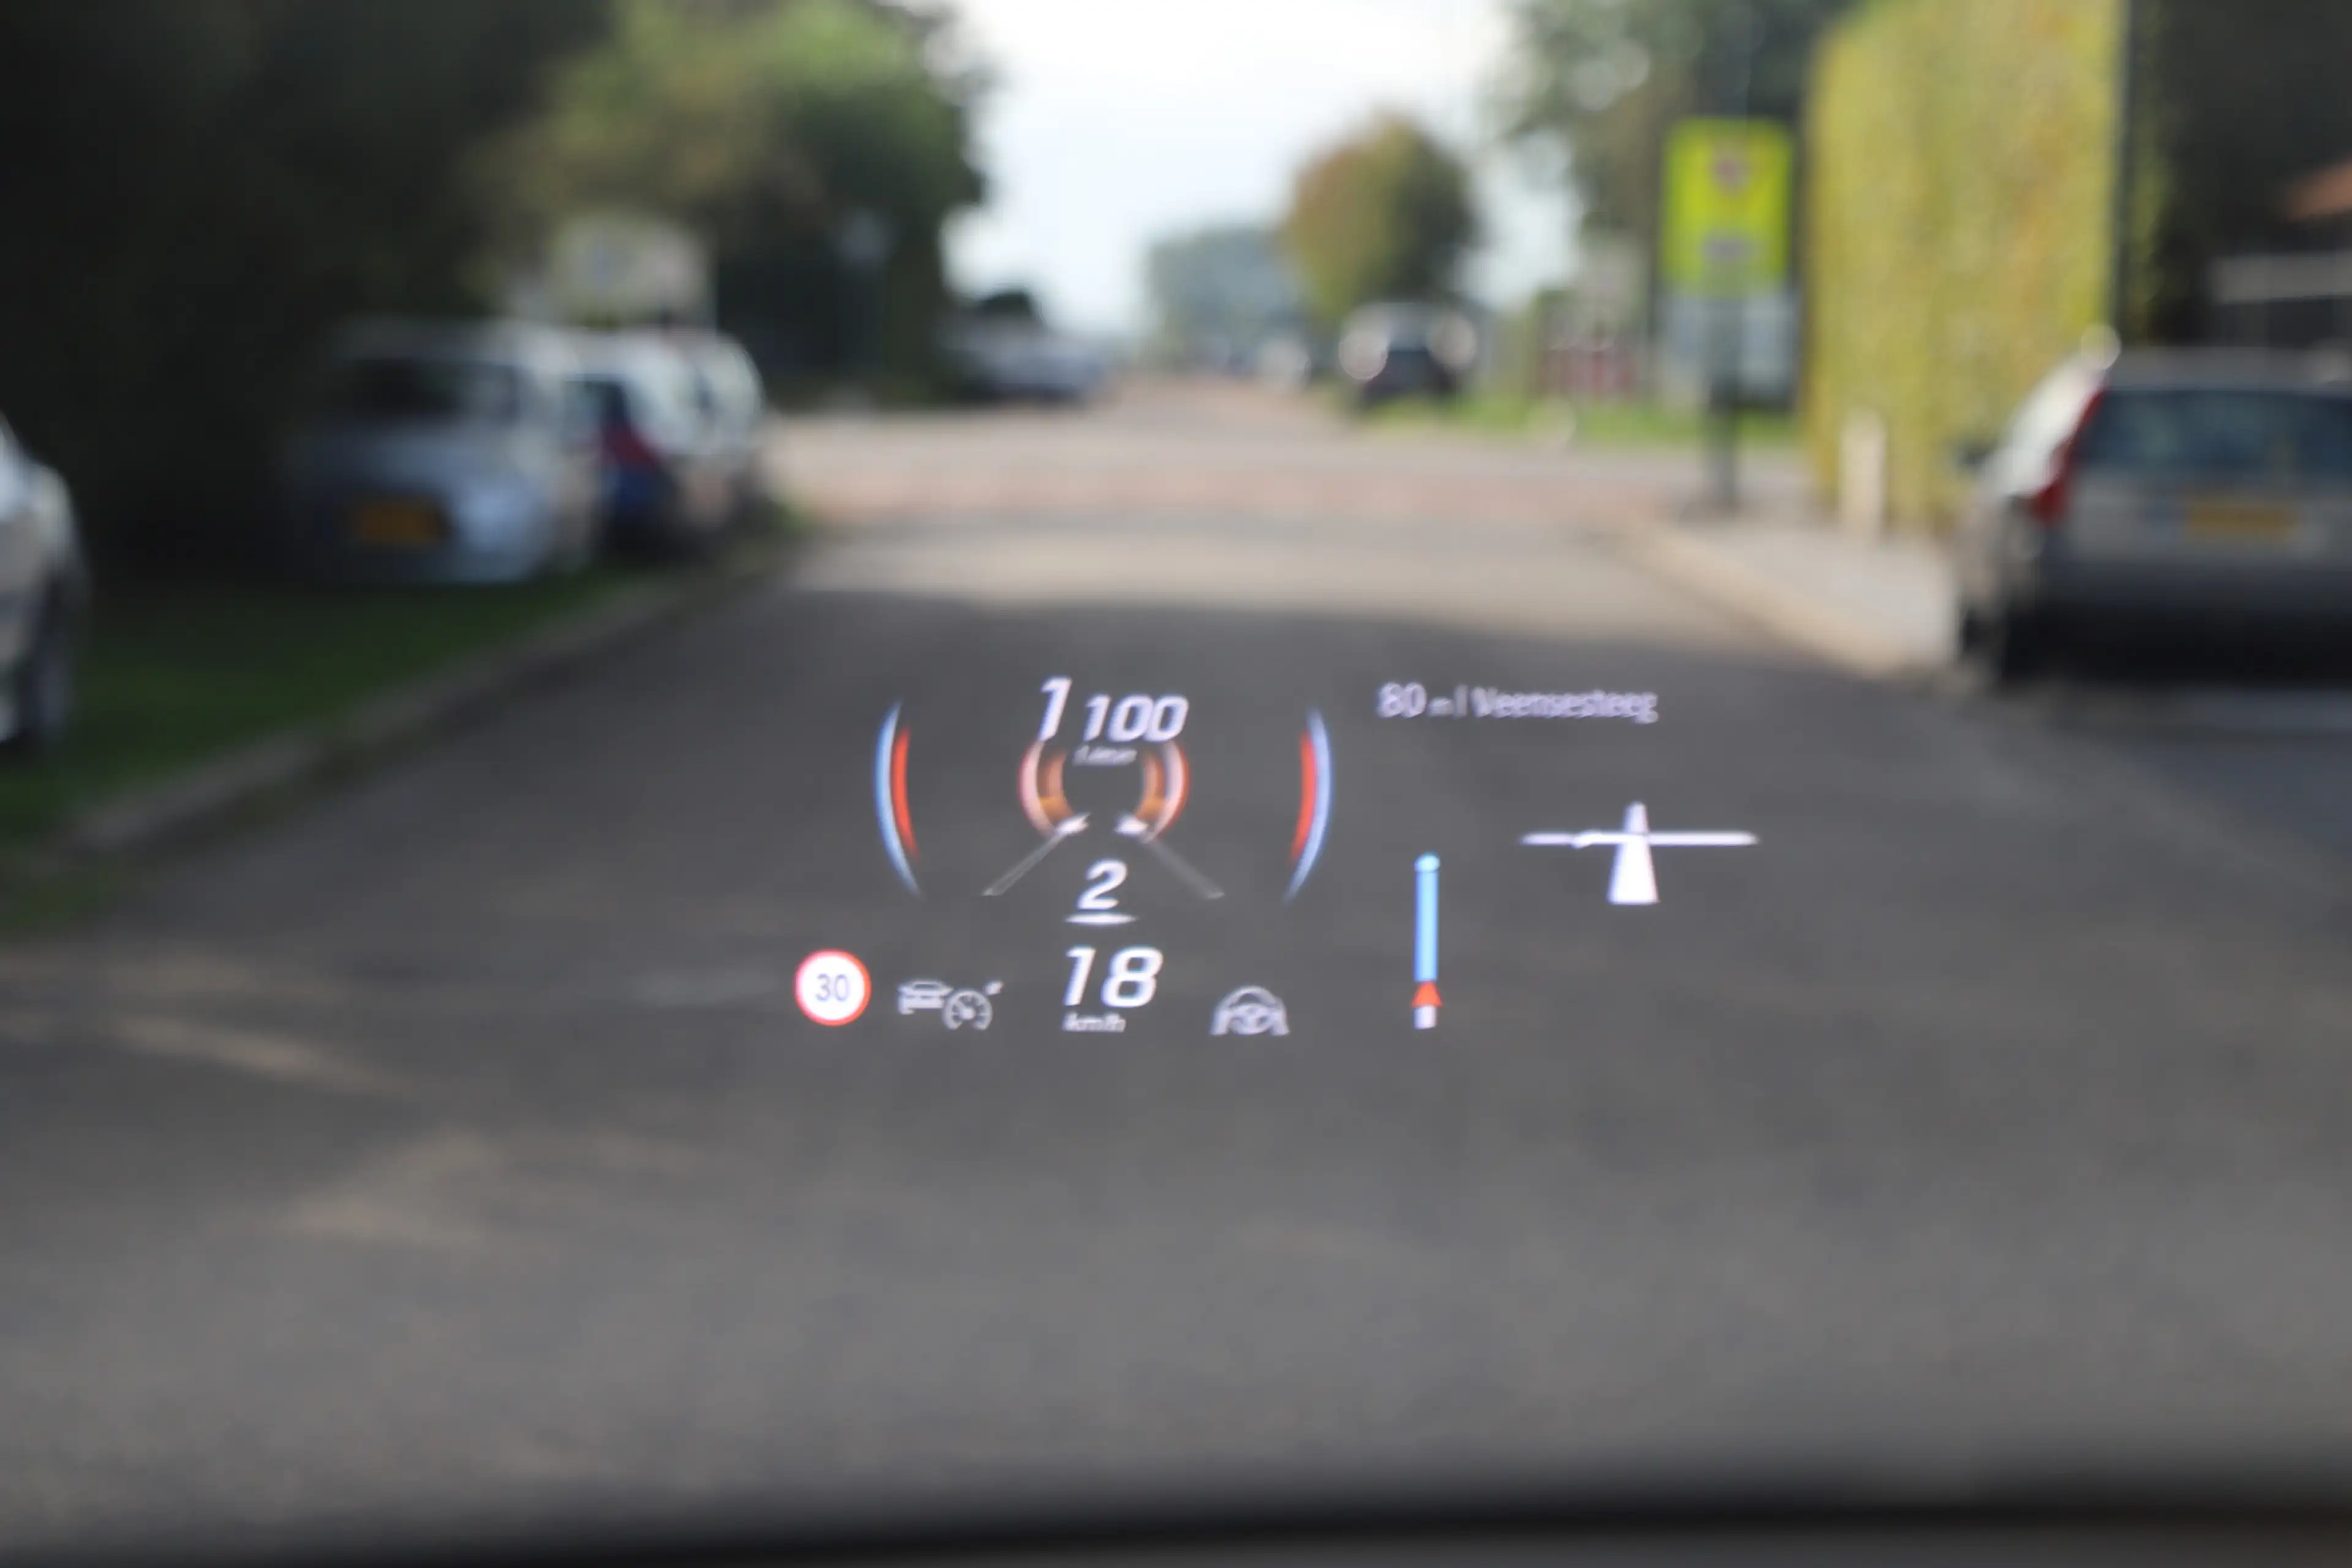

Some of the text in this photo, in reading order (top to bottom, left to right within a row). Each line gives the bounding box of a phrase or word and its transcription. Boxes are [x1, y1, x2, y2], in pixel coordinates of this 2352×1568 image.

[1083, 693, 1189, 742] 100
[1376, 682, 1427, 718] 80
[1076, 858, 1128, 911] 2
[815, 973, 850, 1003] 30
[1062, 945, 1164, 1008] 18
